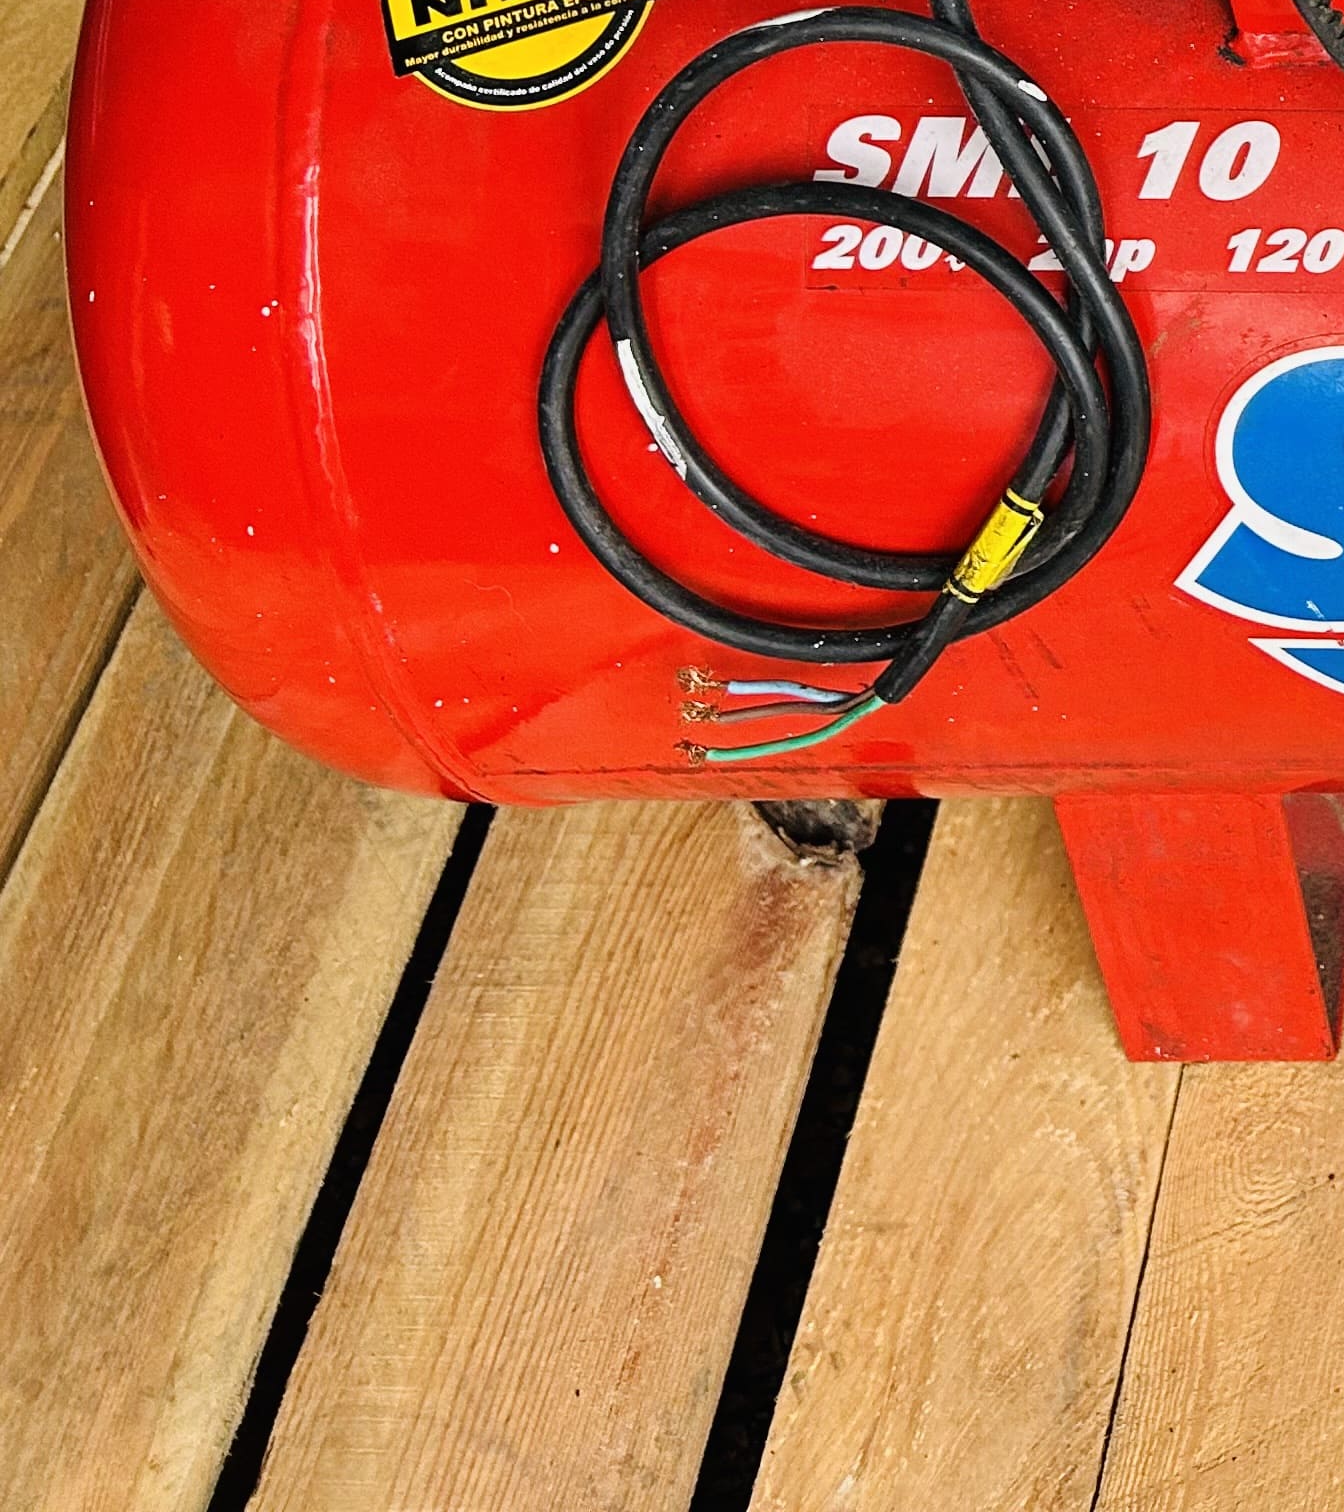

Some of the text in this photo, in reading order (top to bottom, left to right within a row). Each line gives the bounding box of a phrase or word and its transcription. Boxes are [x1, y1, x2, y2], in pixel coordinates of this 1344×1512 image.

[405, 51, 439, 67] Mayor
[441, 30, 505, 56] durabilidad
[506, 28, 514, 38] y
[516, 8, 578, 34] resistencia
[591, 3, 602, 11] la
[442, 22, 479, 44] CON
[483, 0, 559, 32] PINTURA
[477, 86, 527, 97] certificado
[528, 86, 541, 94] de
[542, 71, 573, 91] calidad
[573, 63, 588, 76] del
[587, 49, 606, 66] vaso
[604, 39, 615, 50] de
[1136, 119, 1281, 202] 10
[811, 224, 966, 273] 200
